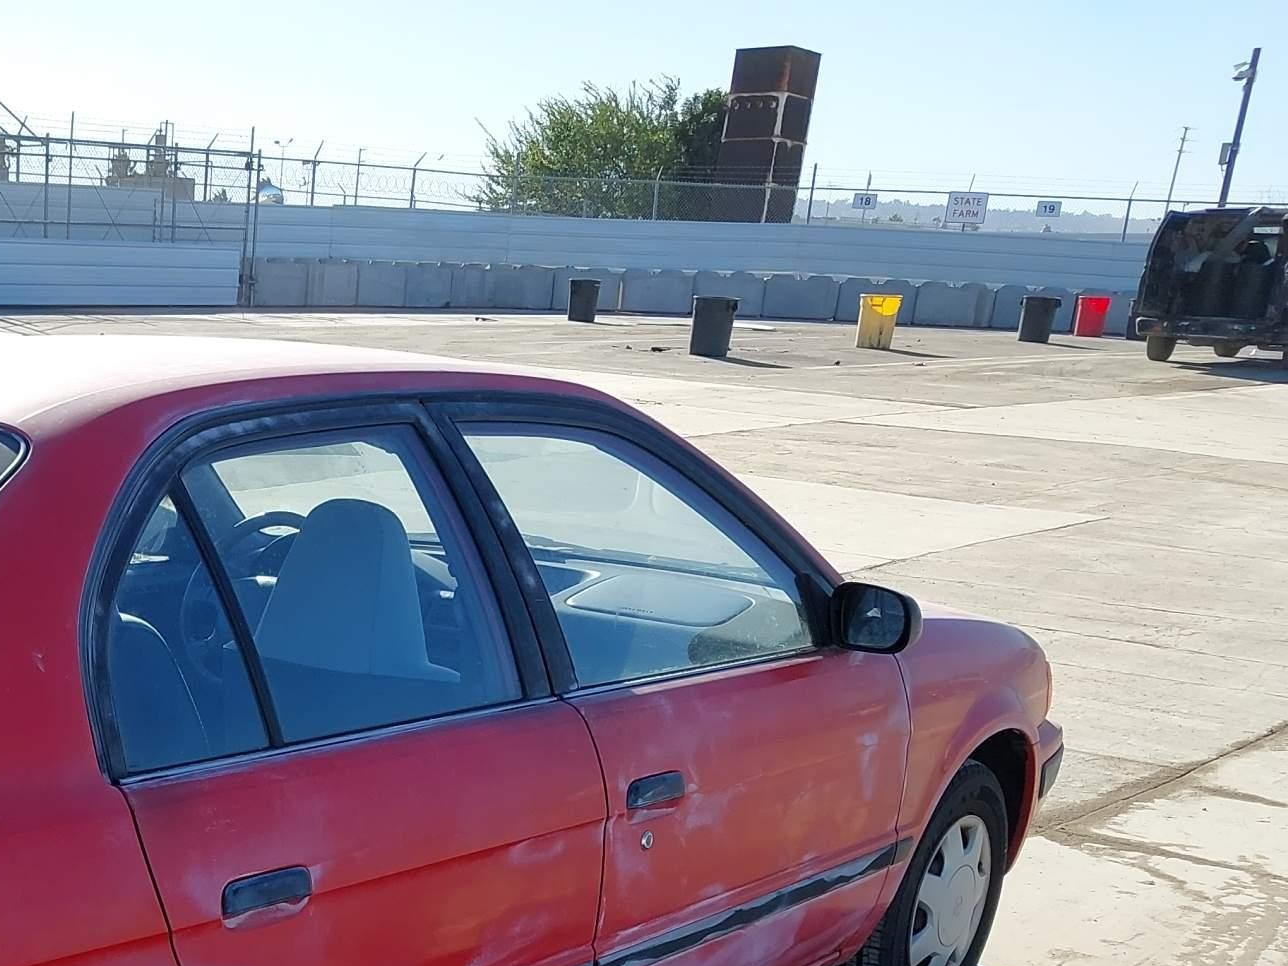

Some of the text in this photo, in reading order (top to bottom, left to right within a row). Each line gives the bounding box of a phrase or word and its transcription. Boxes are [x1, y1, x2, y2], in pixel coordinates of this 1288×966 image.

[859, 196, 871, 206] 18
[953, 196, 983, 207] STATE
[952, 208, 979, 219] FARM
[1043, 204, 1056, 214] 19
